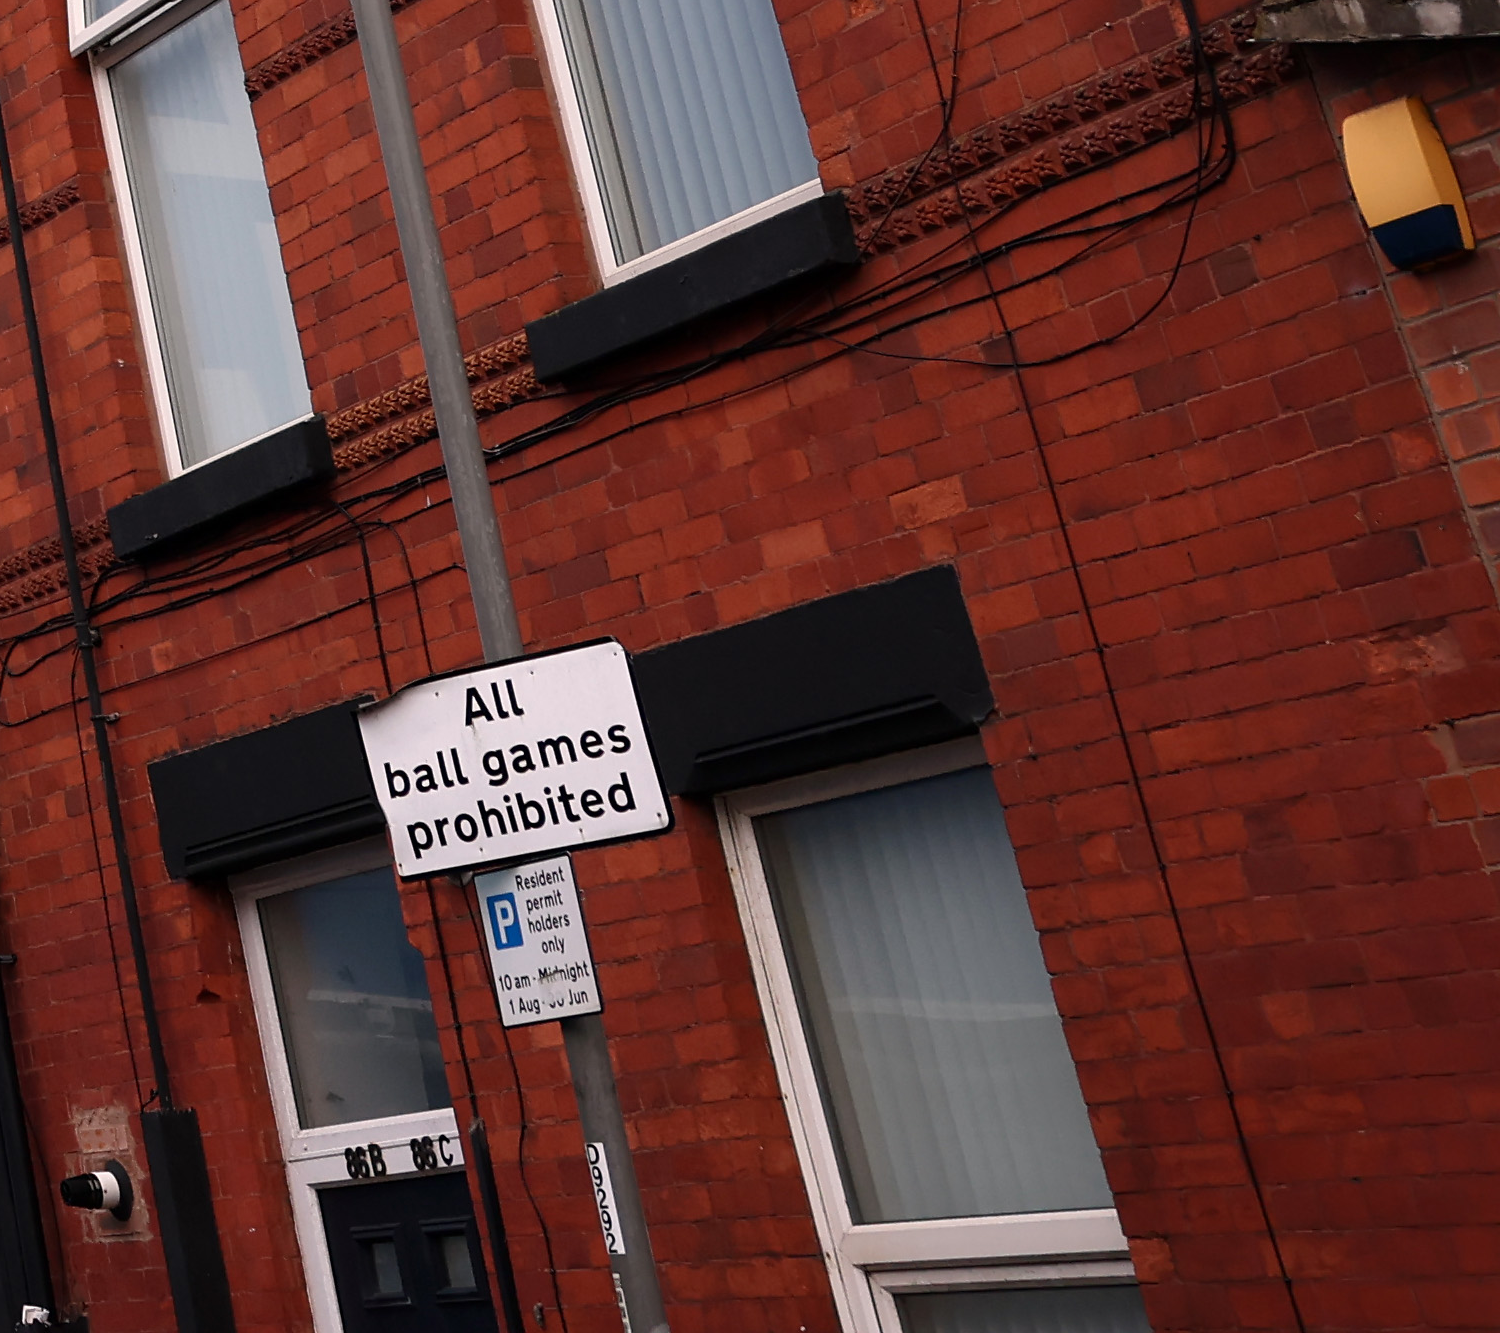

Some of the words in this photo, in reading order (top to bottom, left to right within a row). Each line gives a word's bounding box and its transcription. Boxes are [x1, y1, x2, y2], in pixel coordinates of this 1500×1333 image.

[463, 678, 525, 727] All
[384, 747, 469, 800] ball
[482, 723, 632, 787] games
[407, 772, 637, 859] prohibited
[515, 866, 565, 892] Resident
[525, 890, 563, 914] permit
[493, 899, 515, 944] P
[527, 913, 570, 934] holders
[541, 935, 565, 954] only
[499, 973, 512, 992] 10
[514, 975, 531, 989] am
[509, 999, 516, 1015] 1
[519, 997, 541, 1015] Aug
[569, 989, 589, 1006] Jun
[586, 1143, 618, 1254] D9292
